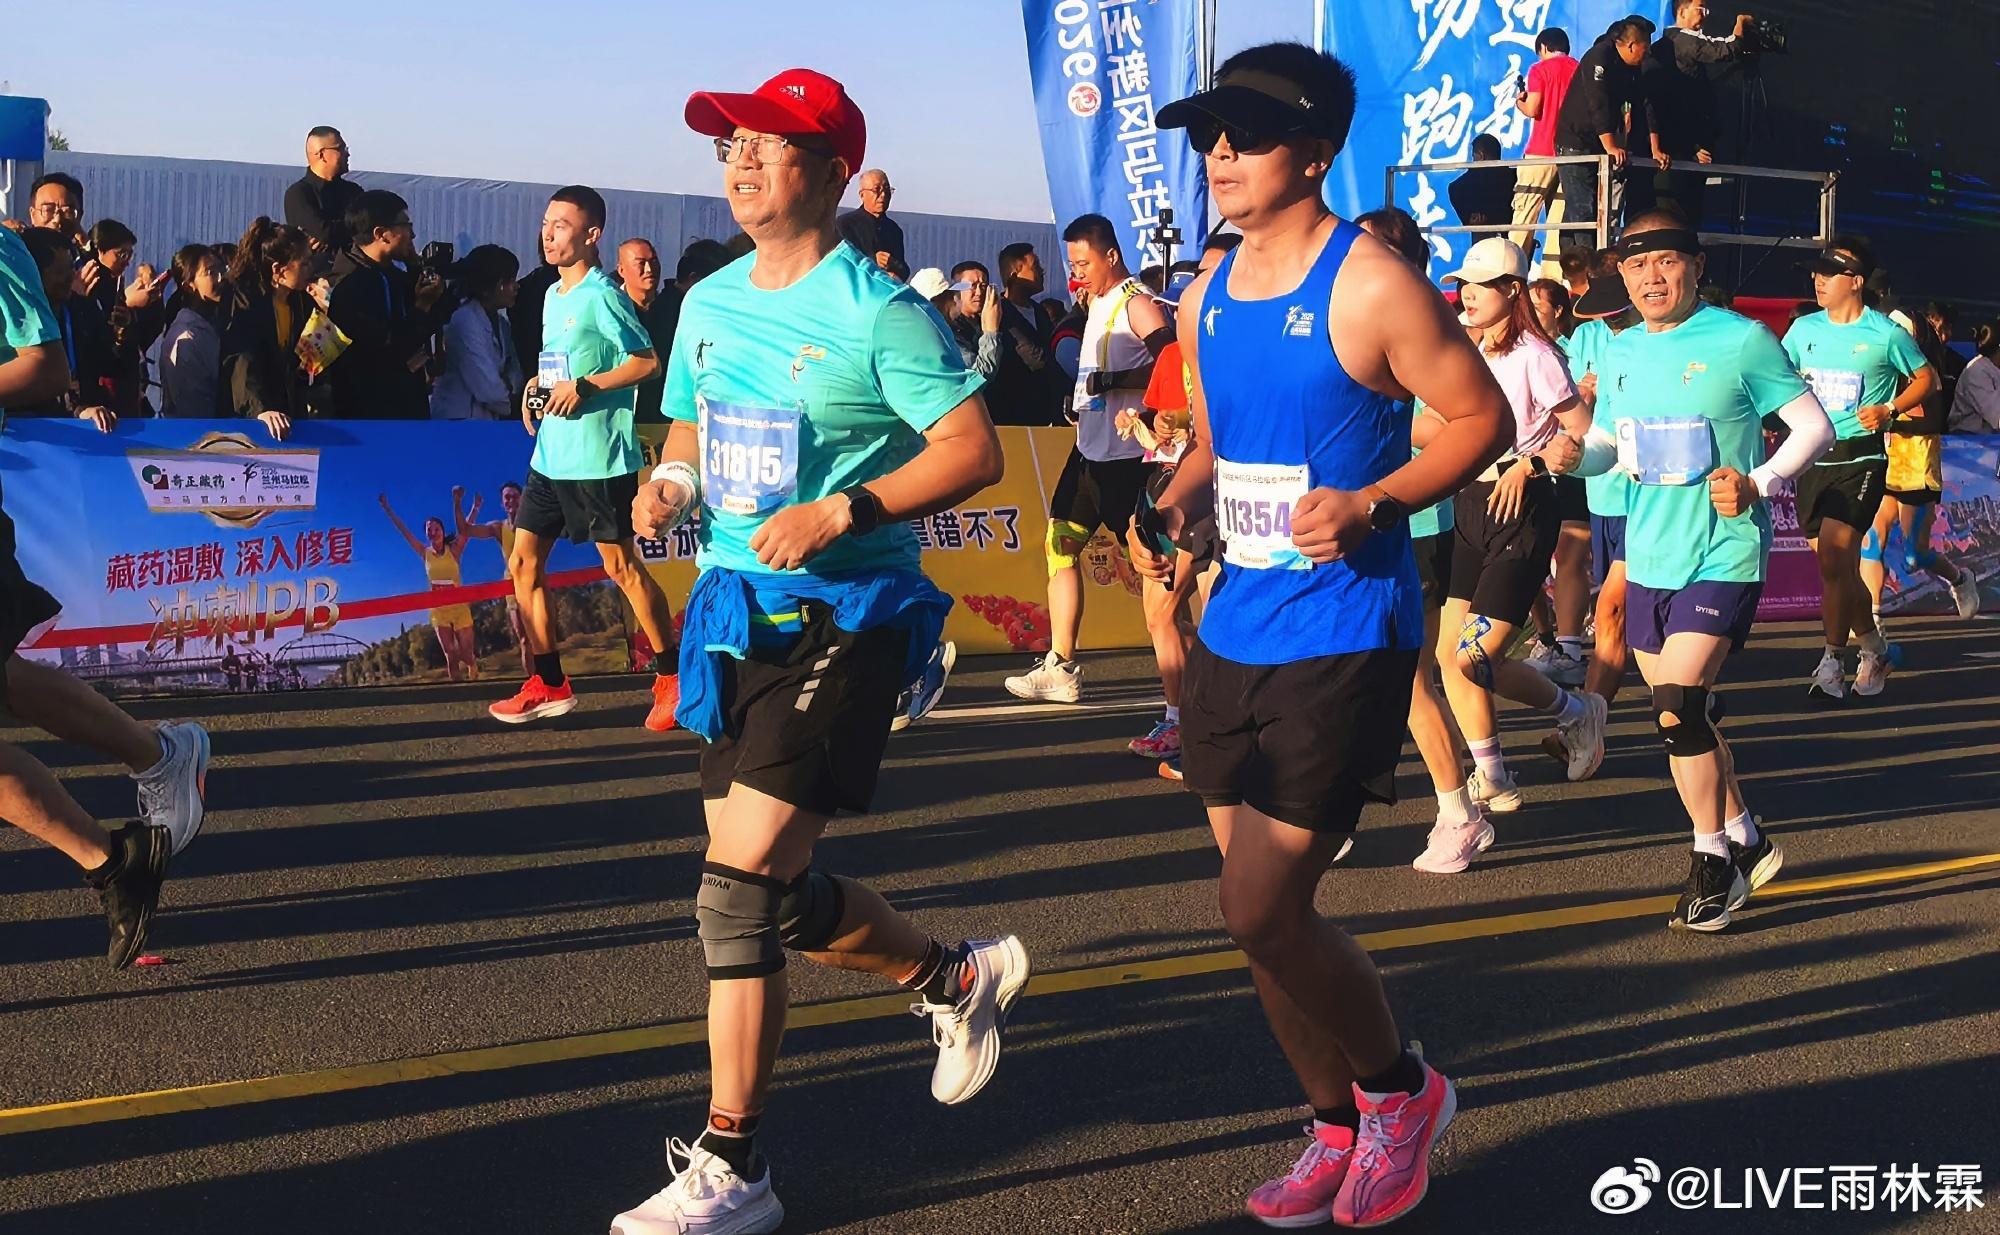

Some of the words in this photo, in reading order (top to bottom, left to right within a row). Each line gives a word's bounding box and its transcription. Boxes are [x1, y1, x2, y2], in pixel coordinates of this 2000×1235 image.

[710, 439, 782, 486] 31815
[1223, 496, 1291, 538] 11354
[107, 541, 225, 593] 藏药湿敷
[235, 527, 353, 577] 深入修复
[145, 576, 340, 655] 冲刺PB
